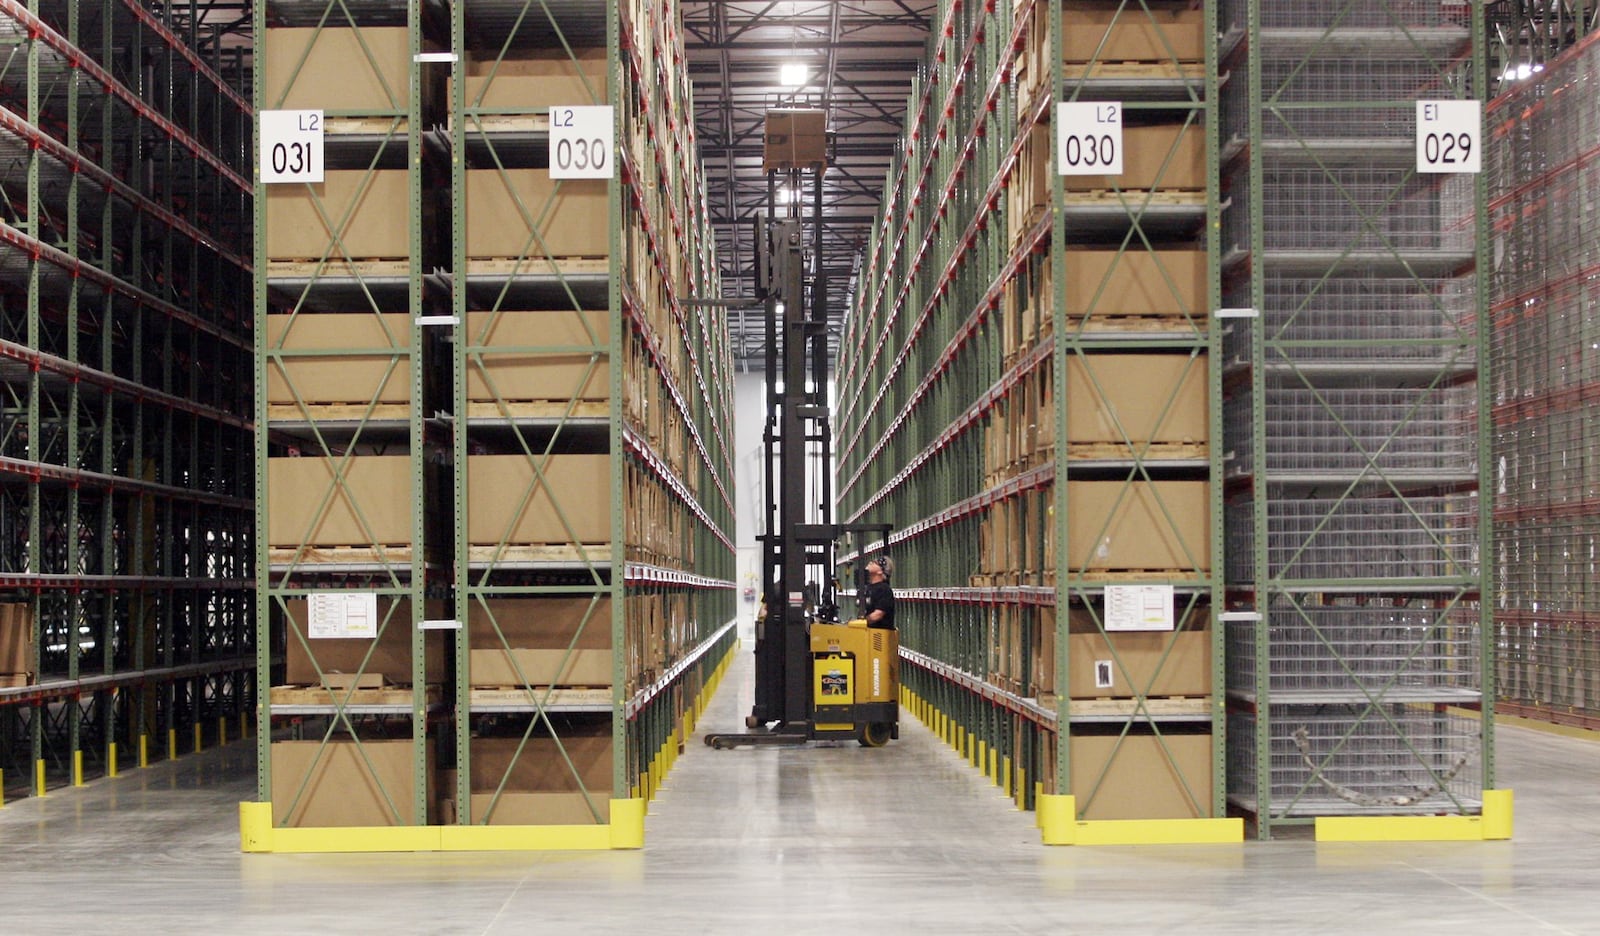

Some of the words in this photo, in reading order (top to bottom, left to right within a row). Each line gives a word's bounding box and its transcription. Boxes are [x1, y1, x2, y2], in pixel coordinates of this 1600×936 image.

[298, 113, 319, 132] L2
[553, 109, 574, 128] L2
[1096, 105, 1117, 124] L2
[1423, 103, 1439, 122] E1
[272, 142, 311, 174] 031
[557, 138, 605, 170] 030
[1066, 134, 1114, 167] 030
[1425, 132, 1471, 164] 029
[872, 658, 880, 697] RAYMOND
